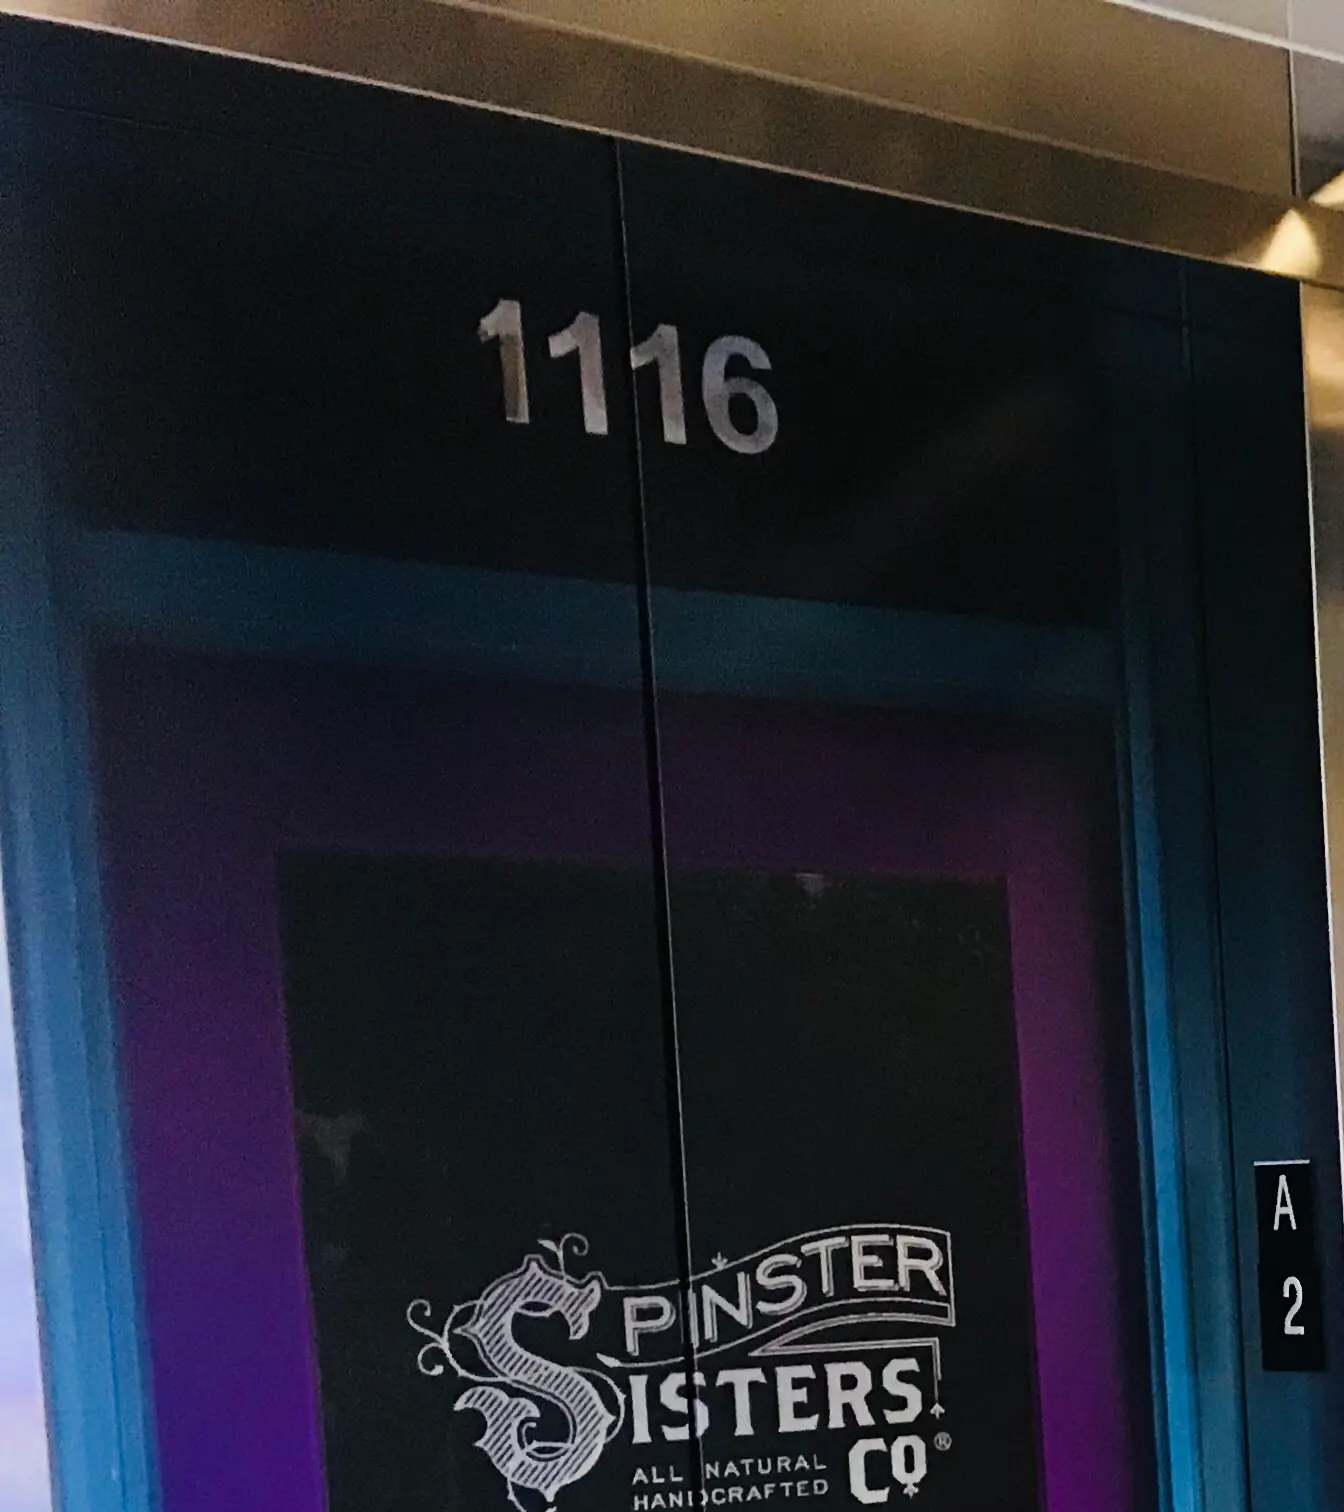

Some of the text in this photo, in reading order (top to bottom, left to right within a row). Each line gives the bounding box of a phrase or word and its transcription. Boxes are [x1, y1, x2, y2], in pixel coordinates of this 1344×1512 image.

[478, 298, 778, 454] 1116
[1273, 1174, 1297, 1231] A
[1282, 1275, 1305, 1336] 2
[632, 1453, 828, 1485] ALL NATURAL
[633, 1478, 829, 1512] HANDCRAFTED
